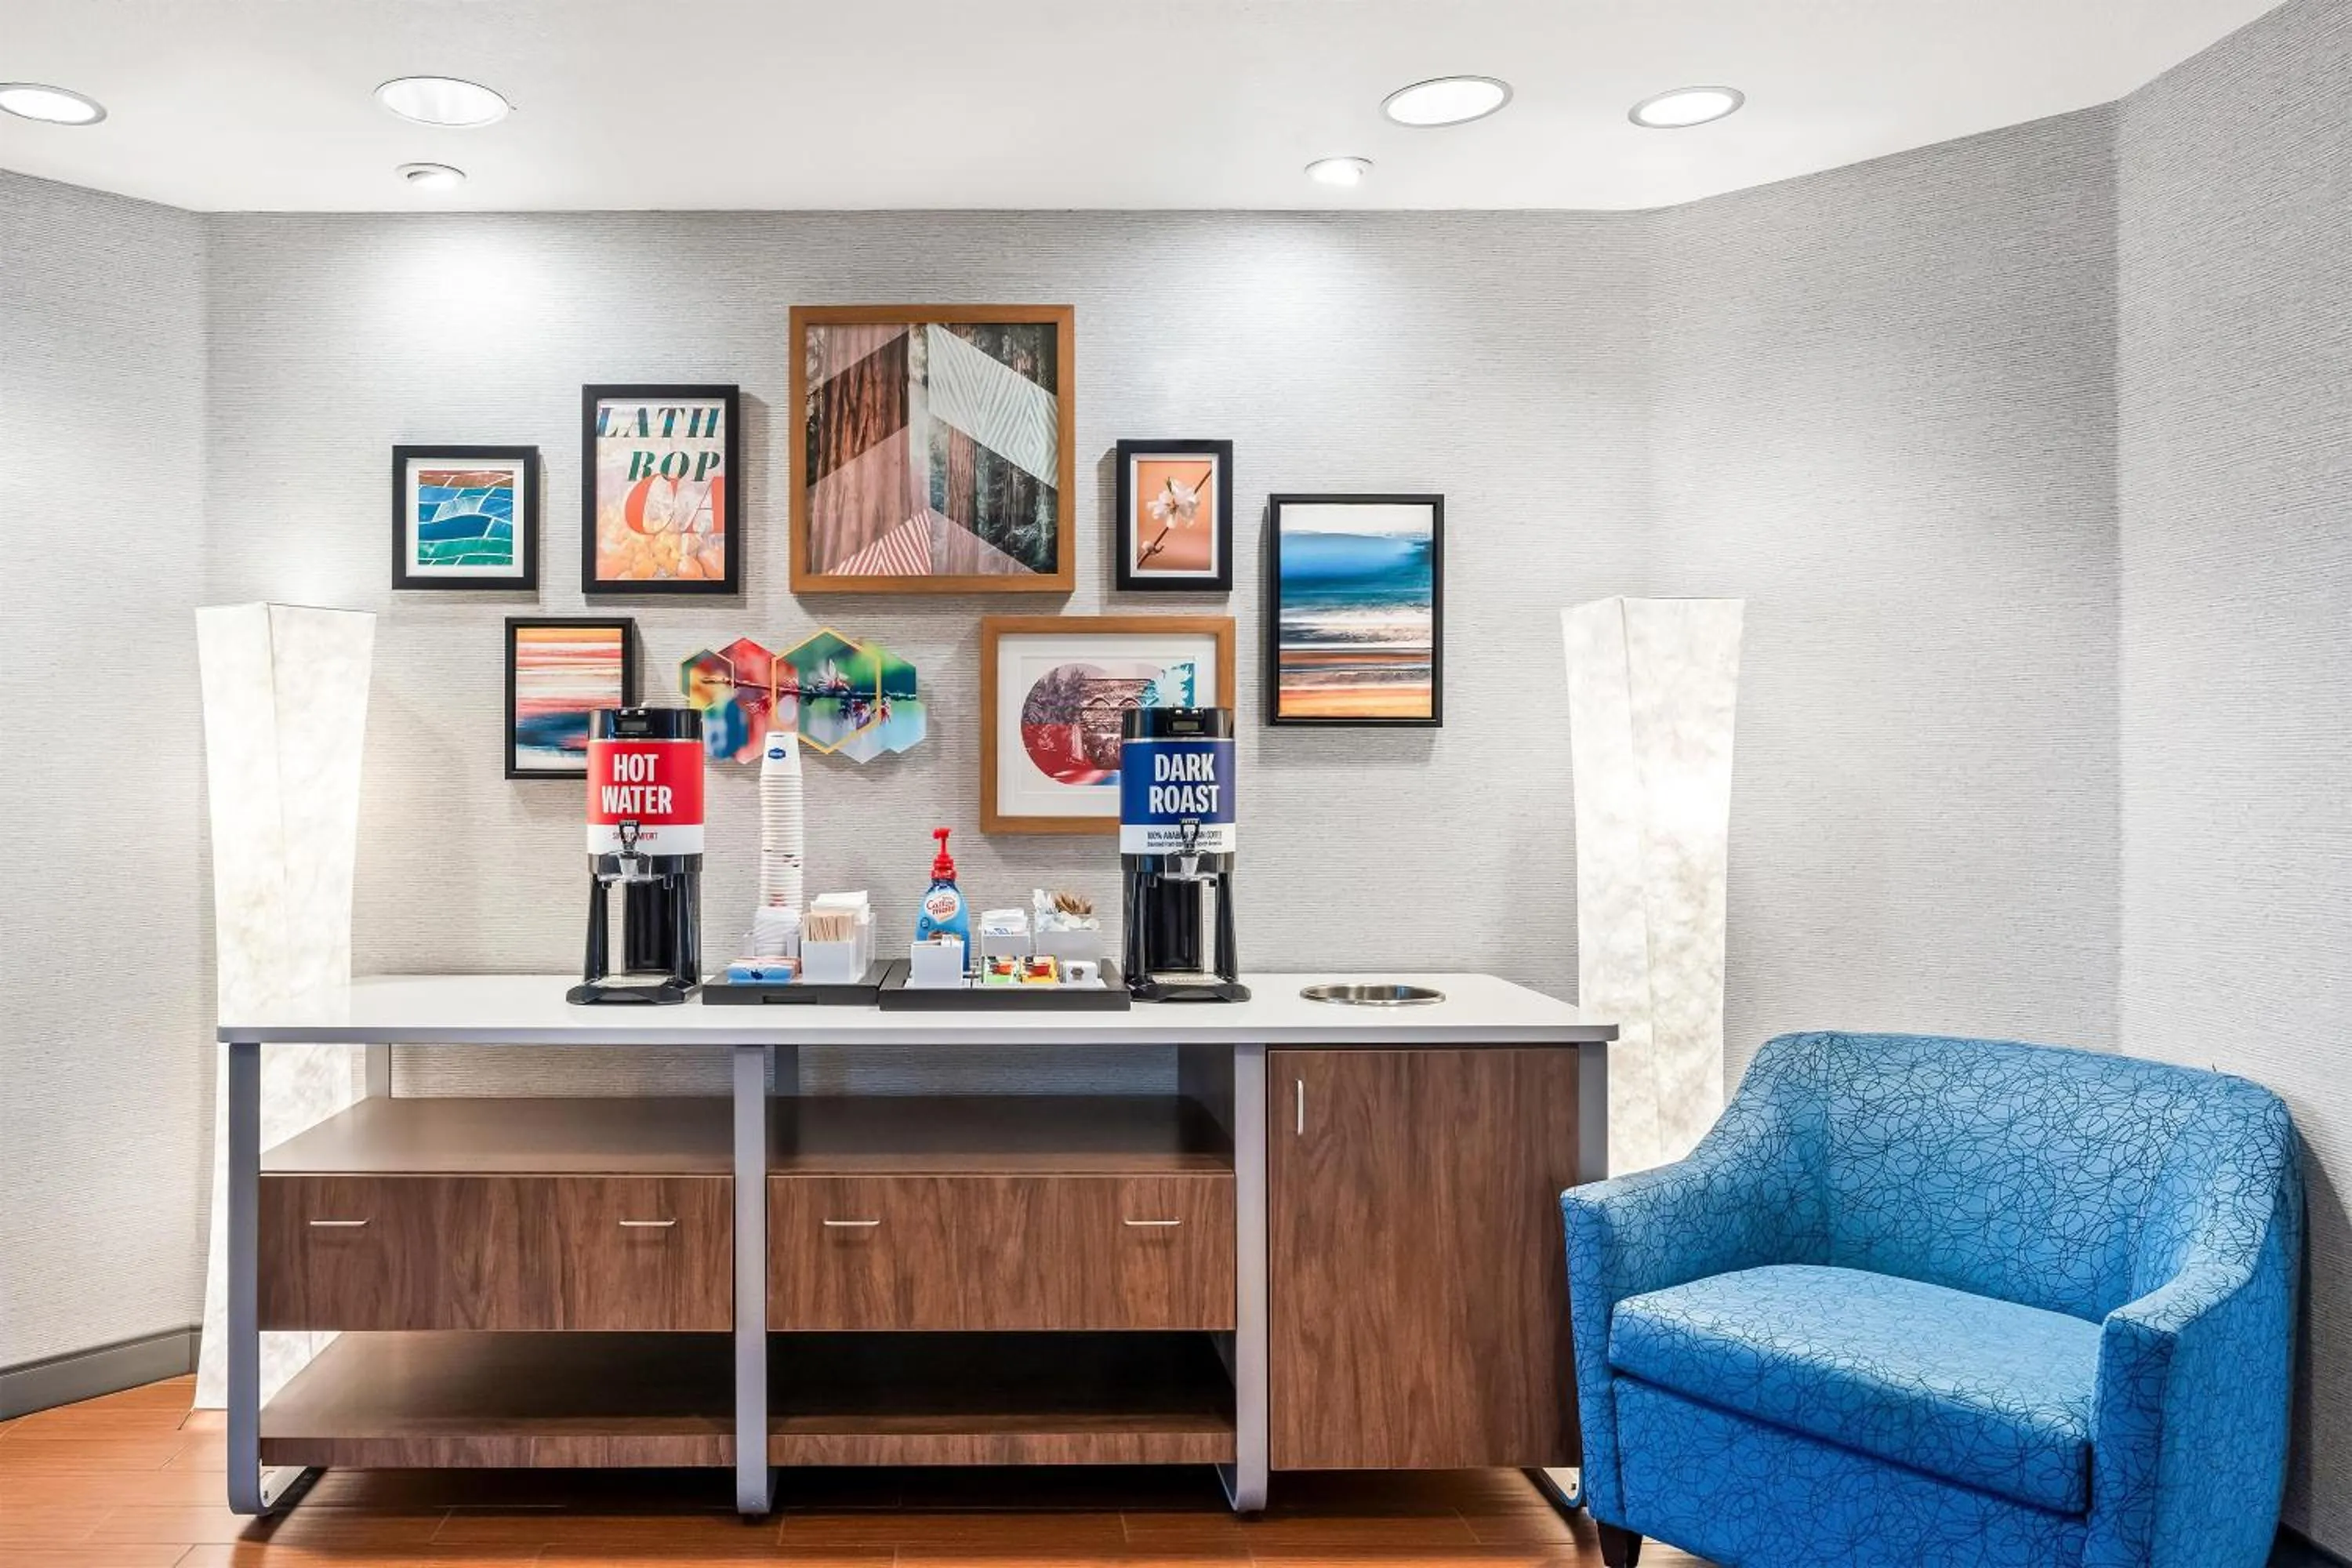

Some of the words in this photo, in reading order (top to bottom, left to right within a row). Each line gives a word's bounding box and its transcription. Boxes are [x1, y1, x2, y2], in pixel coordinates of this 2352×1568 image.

[596, 407, 720, 438] LATH
[628, 451, 720, 482] ROP
[625, 472, 725, 535] CA
[613, 753, 659, 782] HOT
[1154, 753, 1215, 782] DARK
[601, 785, 673, 815] WATER
[1149, 785, 1221, 815] ROAST
